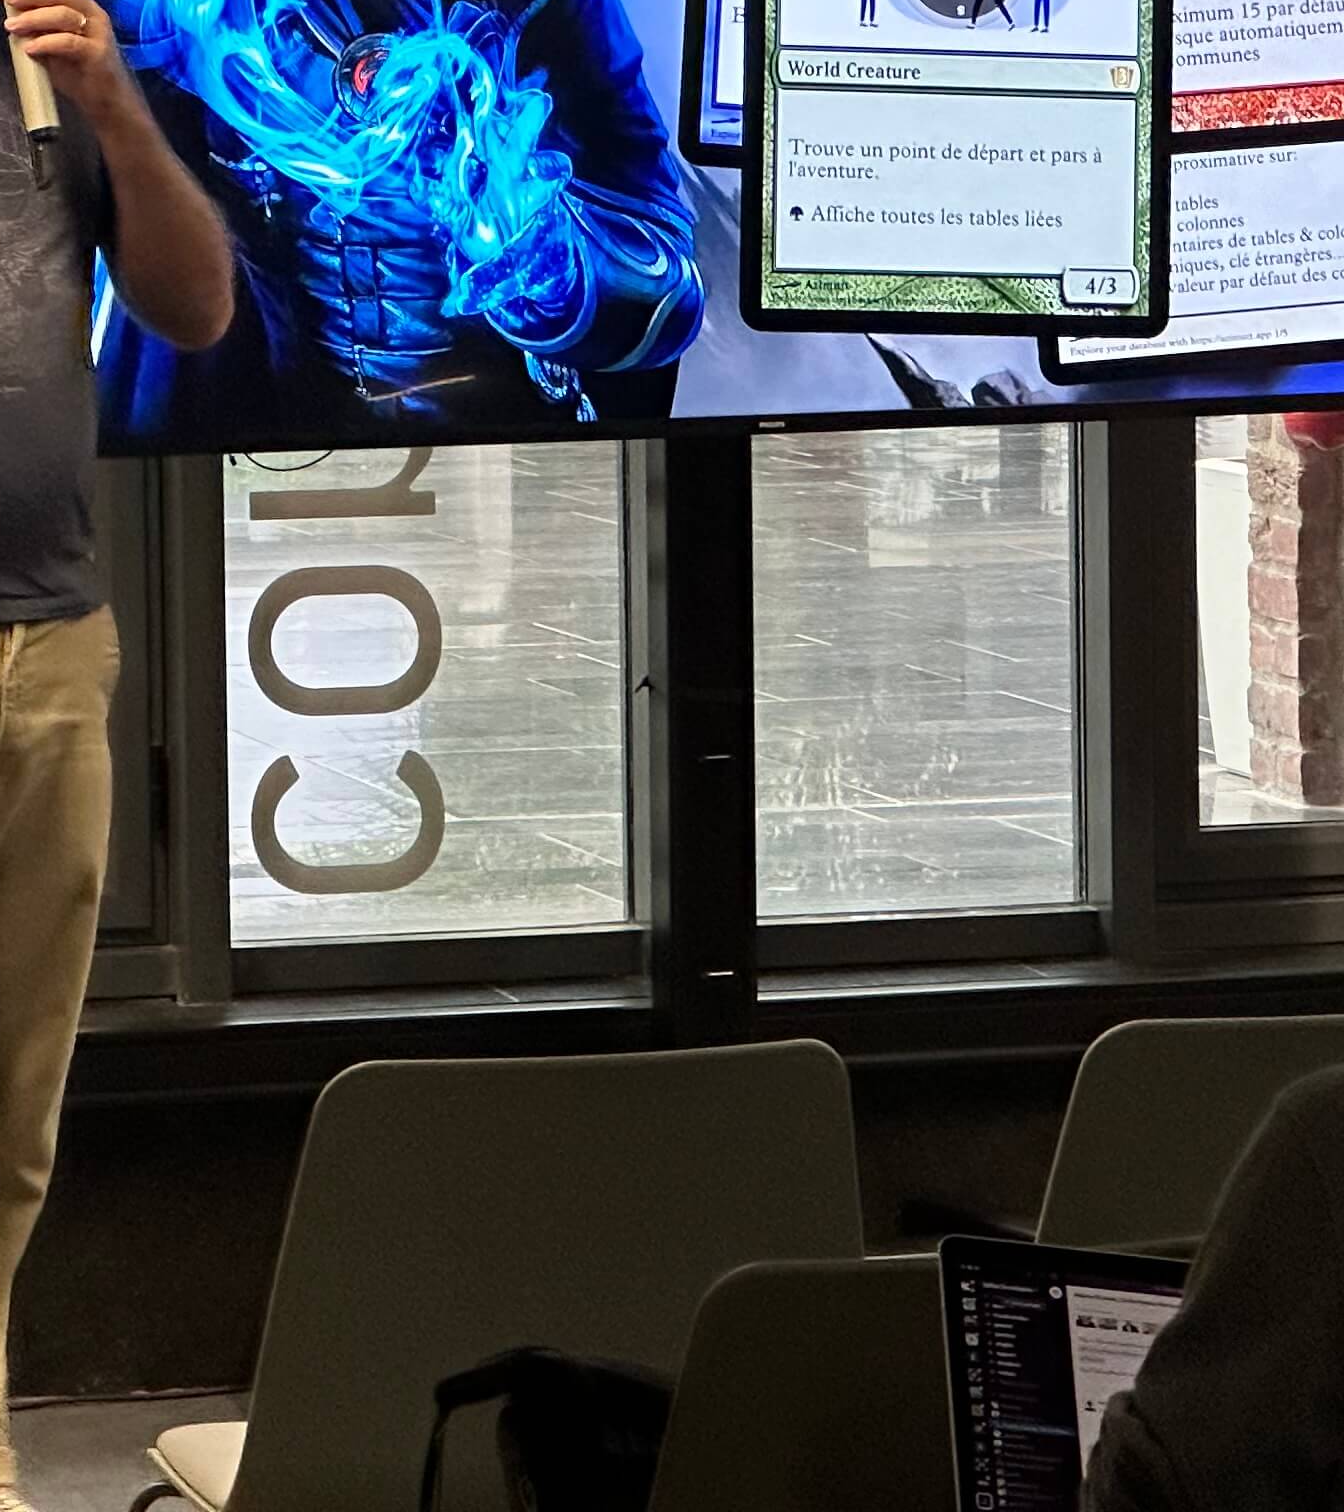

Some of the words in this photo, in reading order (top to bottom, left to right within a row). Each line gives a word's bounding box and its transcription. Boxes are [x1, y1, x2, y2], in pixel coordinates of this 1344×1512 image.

[1241, 1, 1260, 19] 15
[1266, 4, 1295, 22] par
[788, 61, 841, 78] World
[846, 62, 921, 80] Creature
[789, 138, 855, 157] Trouve
[860, 145, 883, 159] un
[889, 142, 936, 162] point
[941, 143, 962, 161] de
[968, 143, 1024, 164] départ
[1029, 148, 1047, 164] et
[1051, 150, 1088, 167] pars
[1092, 150, 1103, 165] à
[1173, 153, 1264, 174] proximative
[1269, 150, 1298, 164] sur:
[789, 161, 881, 180] l'aventure.
[1175, 195, 1219, 212] tables
[810, 204, 876, 225] Affiche
[881, 208, 935, 226] toutes
[940, 208, 963, 227] les
[969, 209, 1019, 228] tables
[1025, 209, 1063, 229] liées
[1177, 214, 1245, 233] colonnes
[1173, 236, 1224, 254] ntaires
[1228, 233, 1246, 249] de
[1251, 229, 1295, 247] tables
[1299, 227, 1313, 242] &
[1229, 253, 1250, 270] clé
[1084, 275, 1118, 298] 4/3
[1219, 277, 1244, 294] par
[1249, 271, 1297, 288] défaut
[1302, 266, 1327, 283] des
